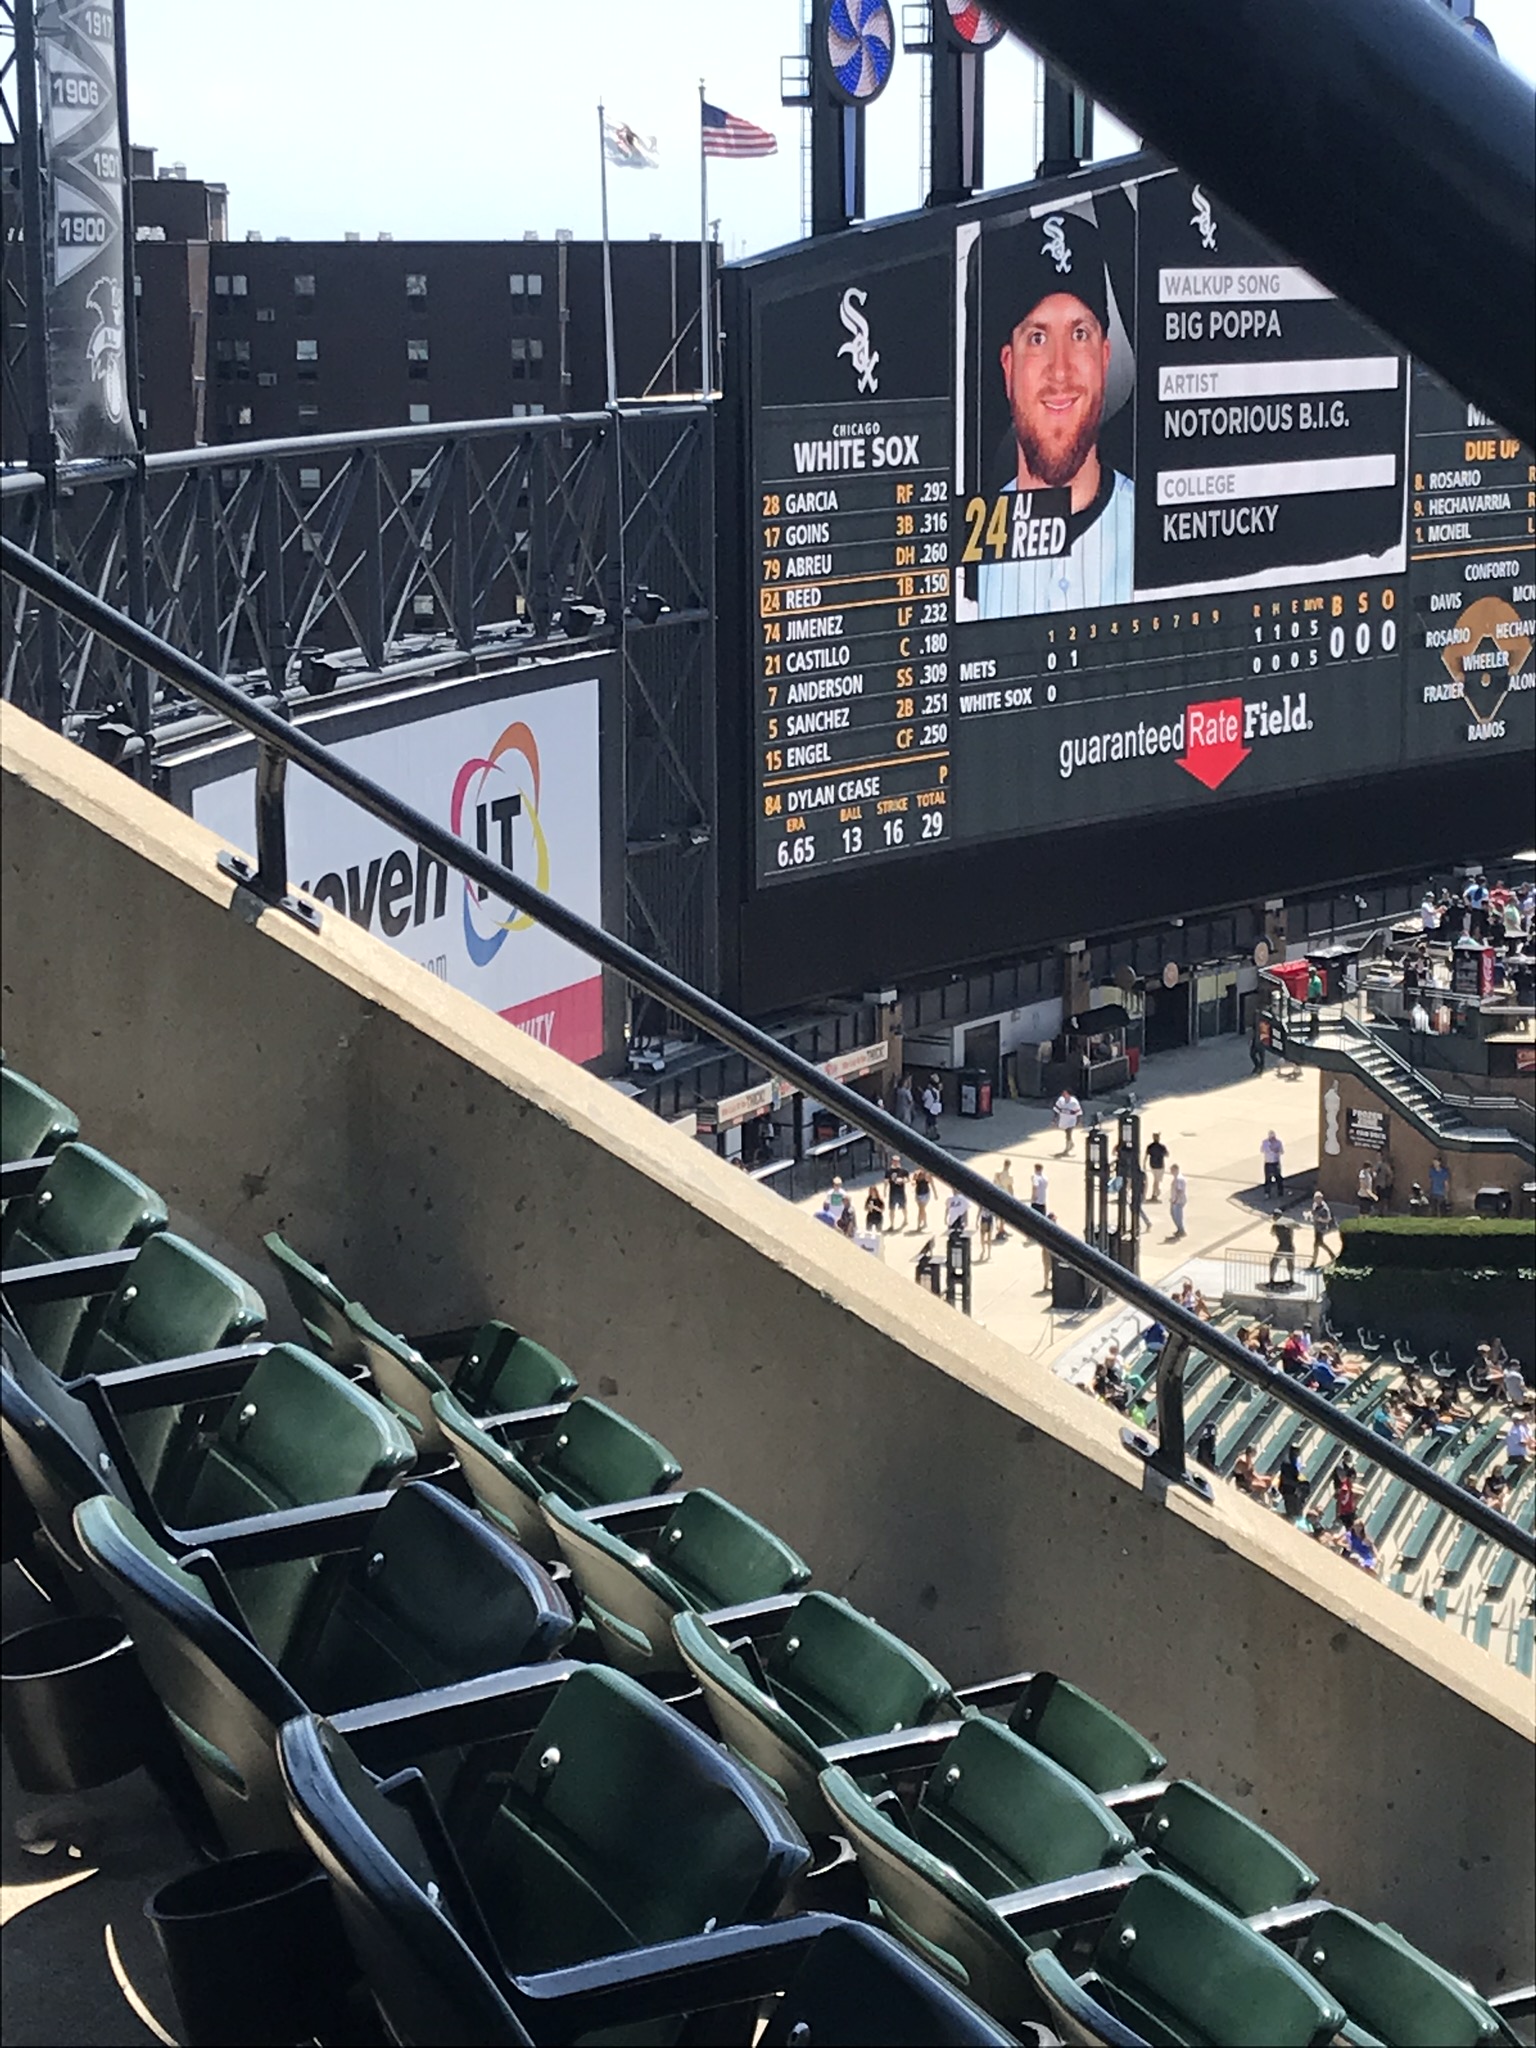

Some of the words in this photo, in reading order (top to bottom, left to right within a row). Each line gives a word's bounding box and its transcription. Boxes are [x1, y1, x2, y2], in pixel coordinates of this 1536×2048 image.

[85, 10, 112, 39] 1917
[53, 78, 99, 106] 1906
[93, 153, 120, 178] 1901
[60, 217, 105, 242] 1900
[1165, 275, 1233, 296] WALKUP
[1238, 274, 1280, 295] SONG
[1166, 311, 1203, 340] BIG
[1210, 309, 1281, 340] POPPA
[1163, 373, 1218, 394] ARTIST
[832, 422, 880, 437] CHICAGO
[1165, 403, 1293, 438] NOTORIOUS
[1300, 400, 1350, 430] B.I.G.
[794, 438, 865, 473] WHITE
[871, 435, 920, 467] SOX
[1465, 440, 1496, 461] DUE
[1500, 440, 1520, 459] UP
[1164, 474, 1235, 498] COLLEGE
[1429, 469, 1481, 490] ROSARIO
[762, 495, 780, 516] 28
[785, 490, 838, 514] GARCIA
[896, 484, 914, 504] RF
[920, 481, 948, 503] .292
[1012, 492, 1033, 521] AJ
[1414, 500, 1424, 517] 9.
[1429, 493, 1511, 516] HECHAVARRIA
[763, 527, 781, 547] 17
[785, 523, 830, 547] GOINS
[896, 515, 914, 535] 3B
[920, 512, 948, 533] .316
[961, 495, 1009, 562] 24
[1011, 517, 1066, 559] REED
[1163, 504, 1279, 542] KENTUCKY
[1415, 527, 1424, 543] 1.
[1428, 522, 1471, 543] MCNEIL
[763, 559, 781, 580] 79
[786, 554, 832, 578] ABREU
[896, 546, 915, 566] DH
[920, 543, 948, 564] .260
[1465, 560, 1520, 582] CONFORTO
[763, 592, 780, 611] 24
[786, 587, 821, 610] REED
[896, 577, 914, 596] 1B
[920, 574, 948, 594] .150
[1430, 592, 1462, 611] DAVIS
[763, 624, 780, 644] 74
[786, 615, 844, 642] JIMENEZ
[898, 607, 913, 626] LF
[920, 602, 948, 624] .232
[1048, 630, 1055, 643] 1
[1069, 626, 1077, 640] 2
[1090, 624, 1097, 639] 3
[1111, 622, 1119, 634] 4
[1132, 619, 1140, 634] 5
[1152, 616, 1160, 631] 6
[1173, 614, 1181, 629] 7
[1192, 612, 1199, 626] 8
[1212, 609, 1219, 624] 9
[1253, 604, 1261, 618] R
[1272, 602, 1280, 616] H
[1291, 600, 1299, 614] E
[1331, 595, 1343, 617] B
[1358, 591, 1368, 614] S
[764, 654, 781, 676] 21
[786, 645, 850, 673] CASTILLO
[900, 637, 910, 657] C
[920, 633, 948, 655] .180
[960, 659, 997, 681] METS
[1047, 652, 1057, 670] 0
[1070, 649, 1078, 667] 1
[1254, 626, 1262, 643] 1
[1274, 623, 1281, 640] 1
[1291, 622, 1299, 638] 0
[1310, 620, 1318, 636] 5
[1330, 626, 1344, 659] 0
[1356, 622, 1370, 655] 0
[1381, 619, 1396, 651] 0
[1425, 627, 1471, 648] ROSARIO
[1463, 651, 1510, 671] WHEELER
[768, 687, 778, 707] 7
[787, 674, 863, 705] ANDERSON
[897, 667, 914, 688] SS
[920, 663, 948, 685] .309
[960, 691, 1001, 713] WHITE
[1004, 687, 1032, 707] SOX
[1047, 684, 1057, 702] 0
[1253, 657, 1261, 674] 0
[1272, 654, 1280, 671] 0
[1291, 652, 1299, 668] 0
[1309, 649, 1317, 666] 5
[1423, 682, 1465, 703] FRAZIER
[768, 718, 778, 739] 5
[786, 708, 850, 737] SANCHEZ
[896, 698, 914, 719] 2B
[921, 693, 948, 715] .251
[1467, 720, 1505, 741] RAMOS
[766, 750, 782, 771] 15
[786, 743, 831, 768] ENGEL
[896, 728, 914, 749] CF
[920, 723, 948, 745] .250
[1059, 713, 1185, 778] guaranteed
[1190, 709, 1238, 747] Rate
[764, 795, 782, 816] 84
[788, 784, 835, 813] DYLAN
[838, 777, 880, 802] CEASE
[939, 765, 948, 784] P
[786, 816, 806, 833] ERA
[840, 806, 862, 822] BALL
[876, 797, 909, 815] STRIKE
[916, 791, 946, 808] TOTAL
[476, 794, 522, 902] IT
[777, 836, 815, 867] 6.65
[842, 826, 863, 854] 13
[883, 818, 904, 846] 16
[921, 811, 943, 839] 29
